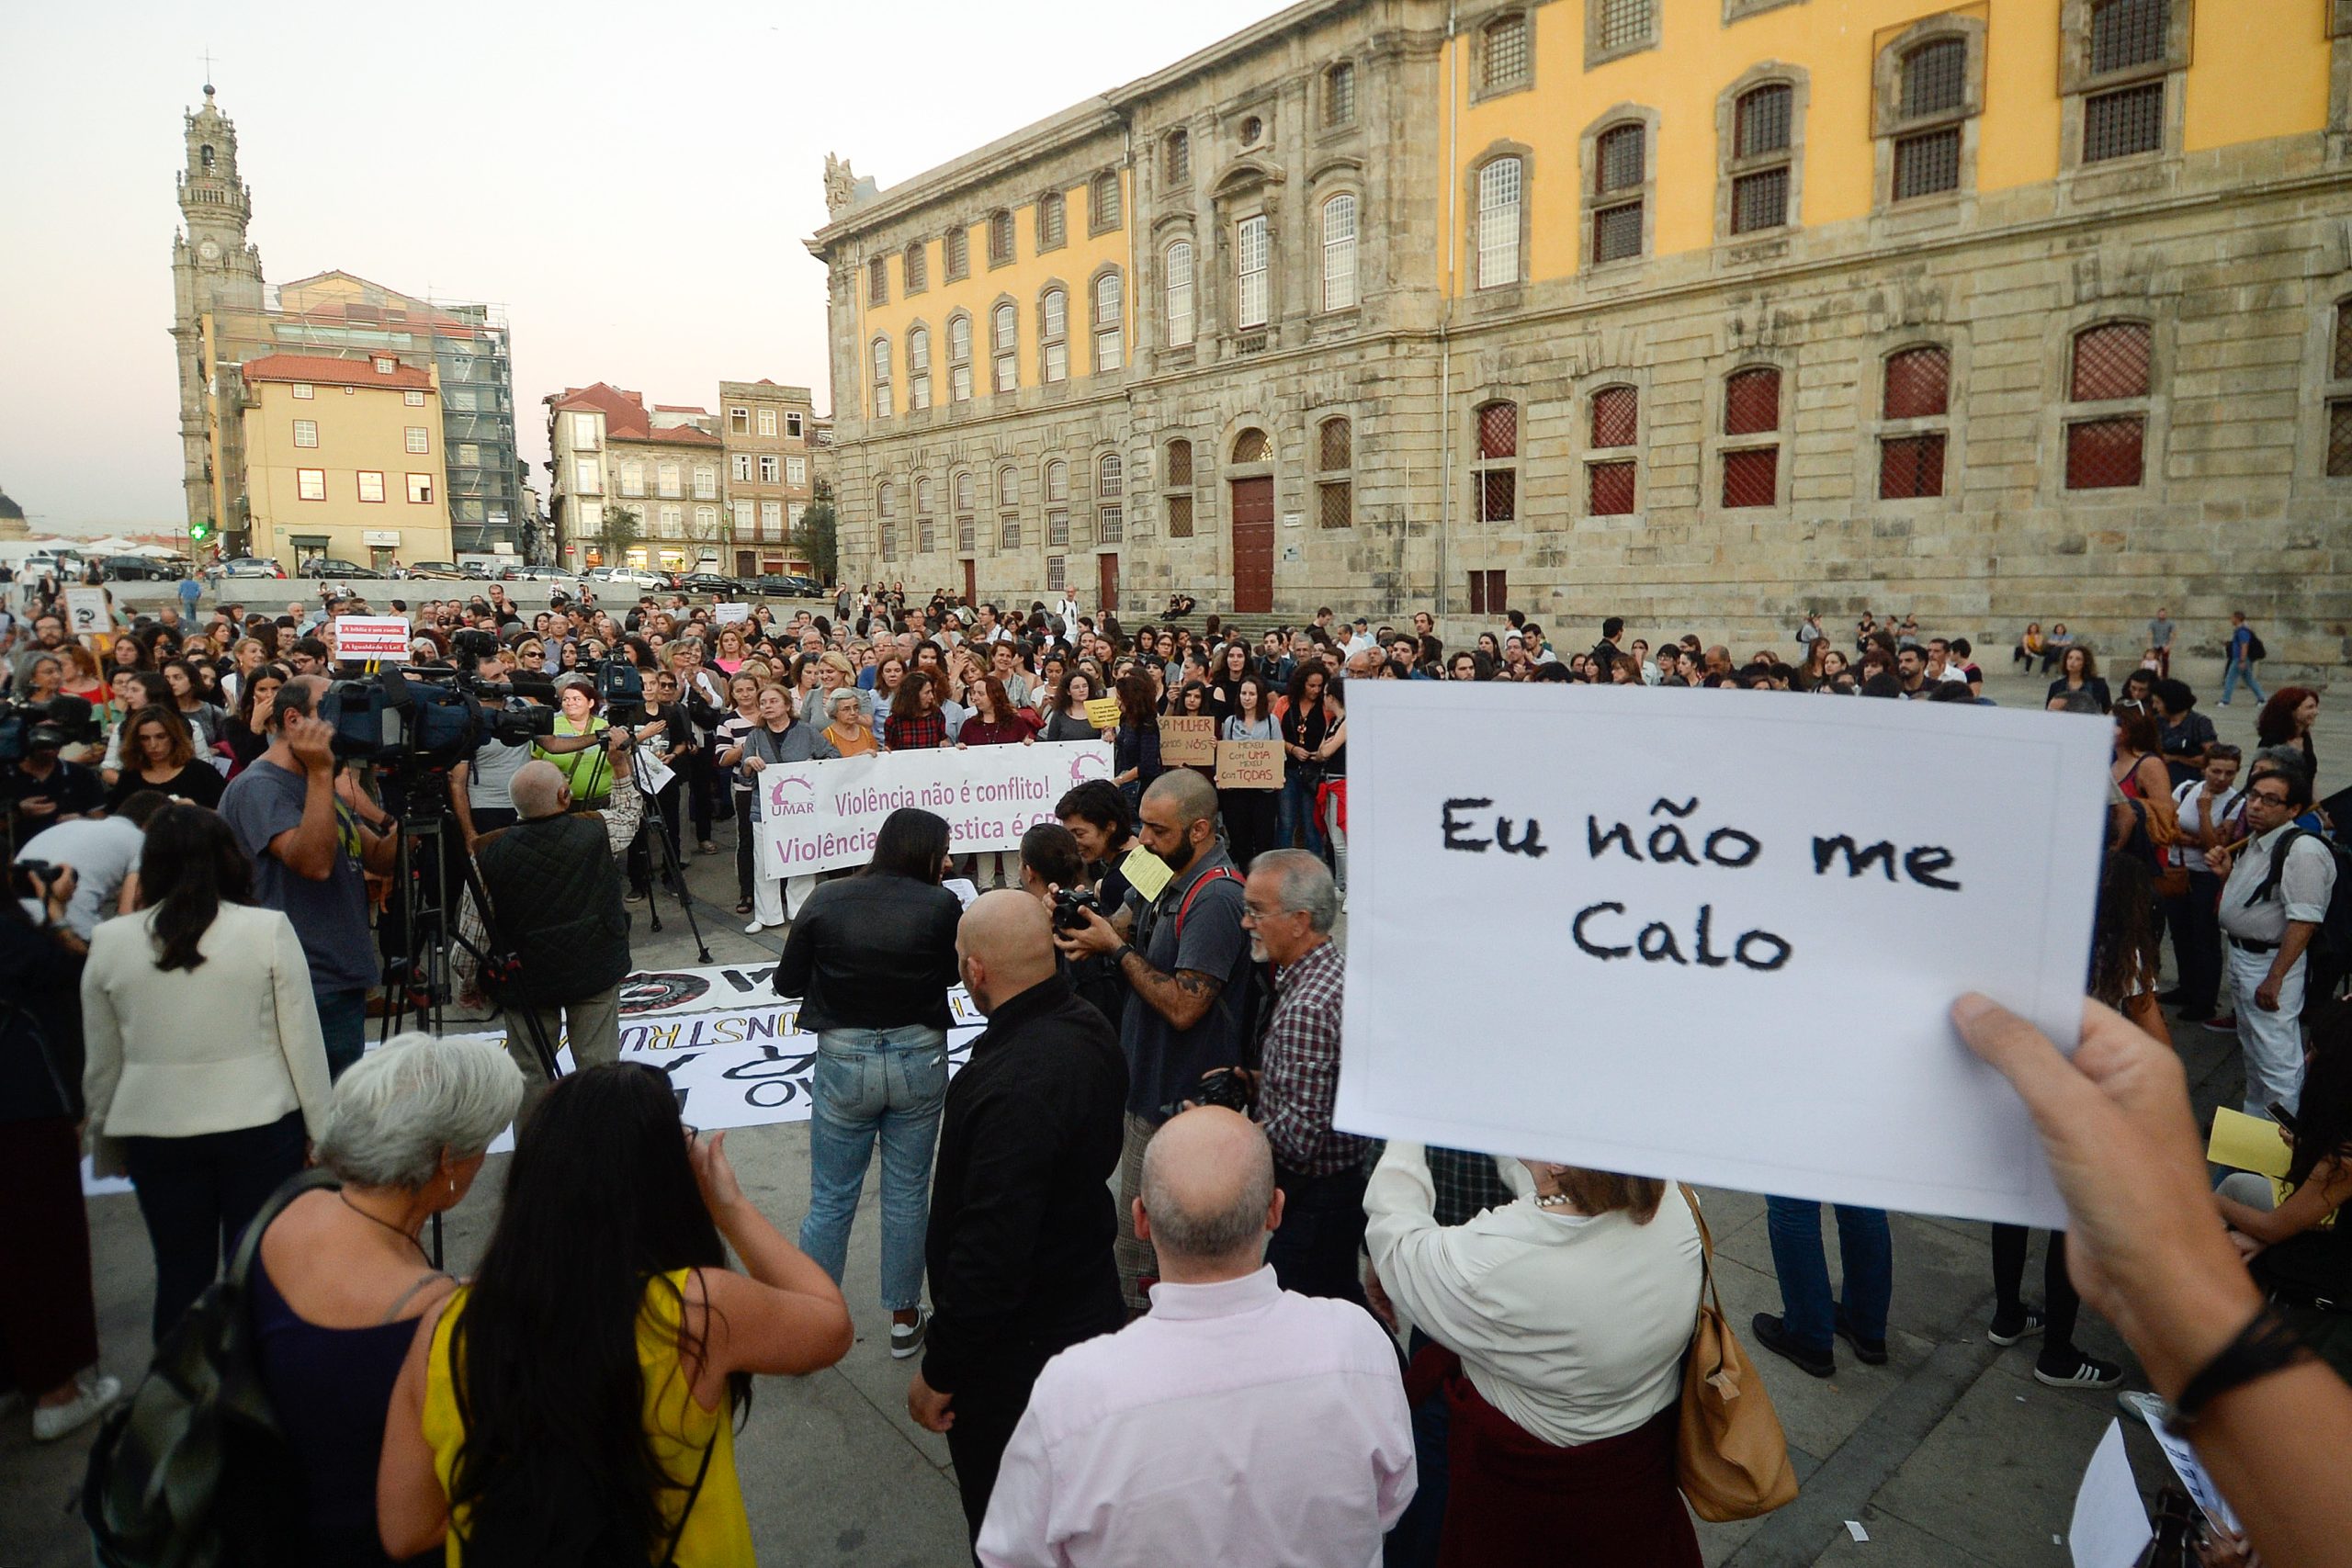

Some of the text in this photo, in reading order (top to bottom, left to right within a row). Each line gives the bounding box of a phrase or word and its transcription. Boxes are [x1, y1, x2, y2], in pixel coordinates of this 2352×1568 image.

[1159, 719, 1211, 732] SA MULHER
[1160, 739, 1182, 748] OMOS
[1238, 741, 1264, 750] MEXEU
[1248, 750, 1271, 761] UMA
[1237, 769, 1273, 782] TODAS
[835, 785, 915, 817] Violência
[921, 782, 955, 807] não
[960, 780, 970, 804] é
[977, 775, 1050, 802] conflito!
[771, 802, 814, 817] UMAR
[775, 827, 877, 864] Violência
[947, 815, 1004, 841] stica
[1012, 812, 1023, 838] é
[1441, 796, 1962, 892] Eu não me
[1572, 900, 1793, 973] Calo
